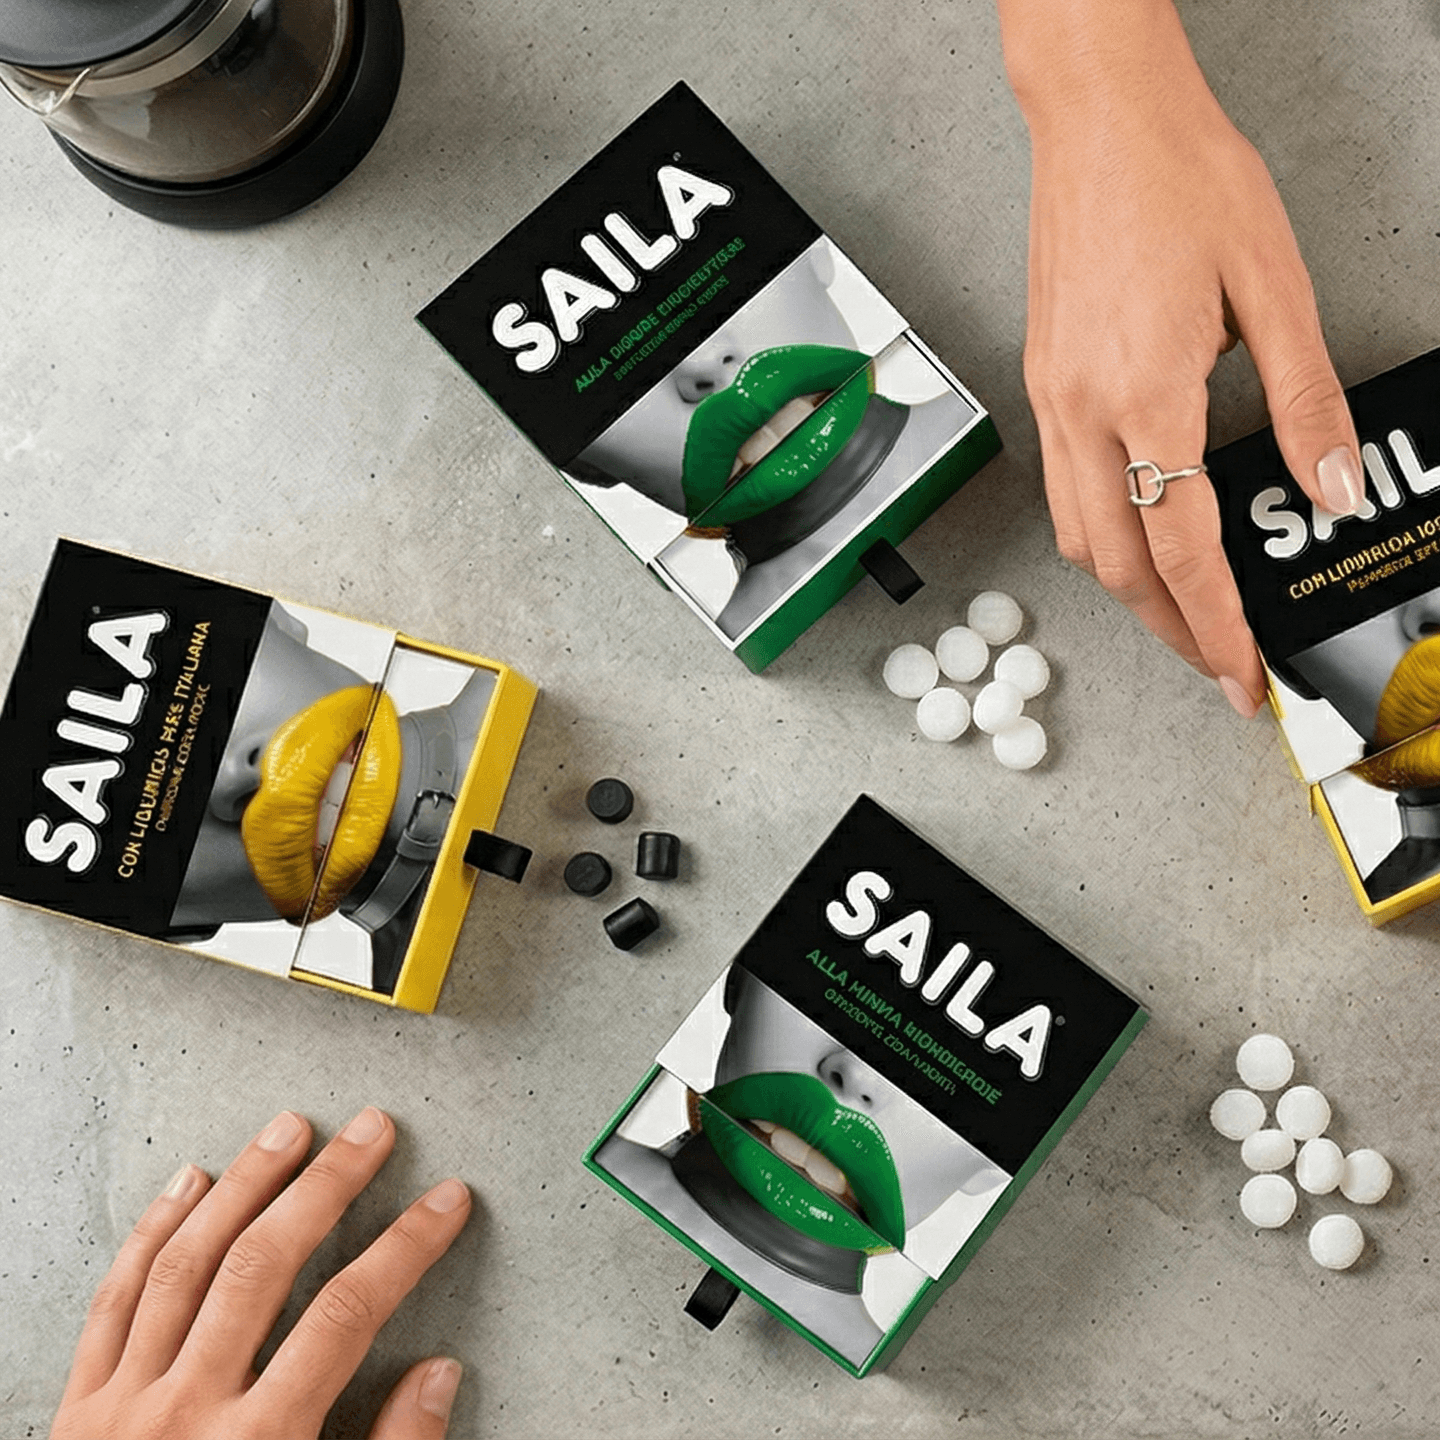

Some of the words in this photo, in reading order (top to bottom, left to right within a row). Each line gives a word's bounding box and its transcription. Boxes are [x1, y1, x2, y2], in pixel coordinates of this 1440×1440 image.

[490, 164, 733, 374] SAILA
[24, 611, 169, 874] SAILA
[805, 949, 848, 987] ALLA
[825, 870, 1053, 1080] SAILA
